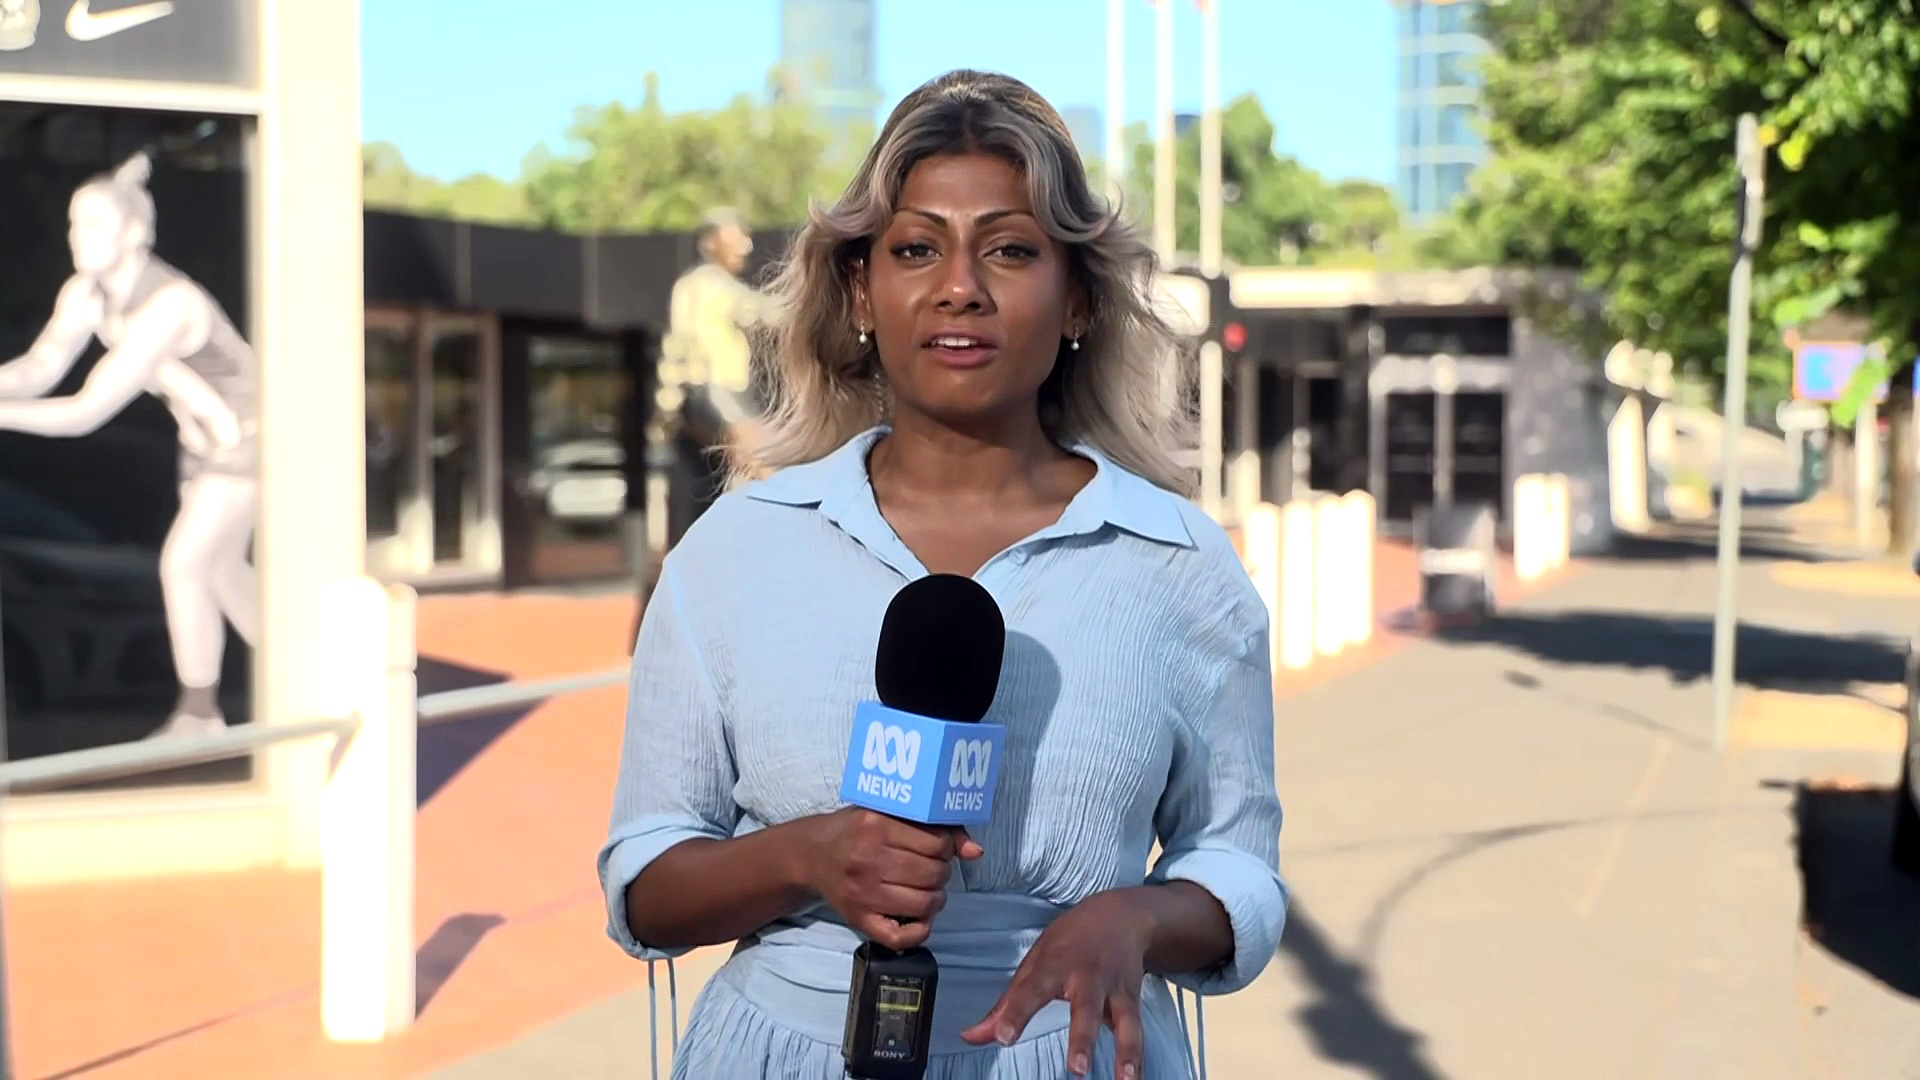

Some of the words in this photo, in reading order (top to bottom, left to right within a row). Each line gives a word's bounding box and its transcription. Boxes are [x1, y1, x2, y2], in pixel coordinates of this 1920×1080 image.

[857, 771, 912, 804] NEWS
[944, 791, 984, 811] NEWS
[873, 1050, 905, 1059] SONY
